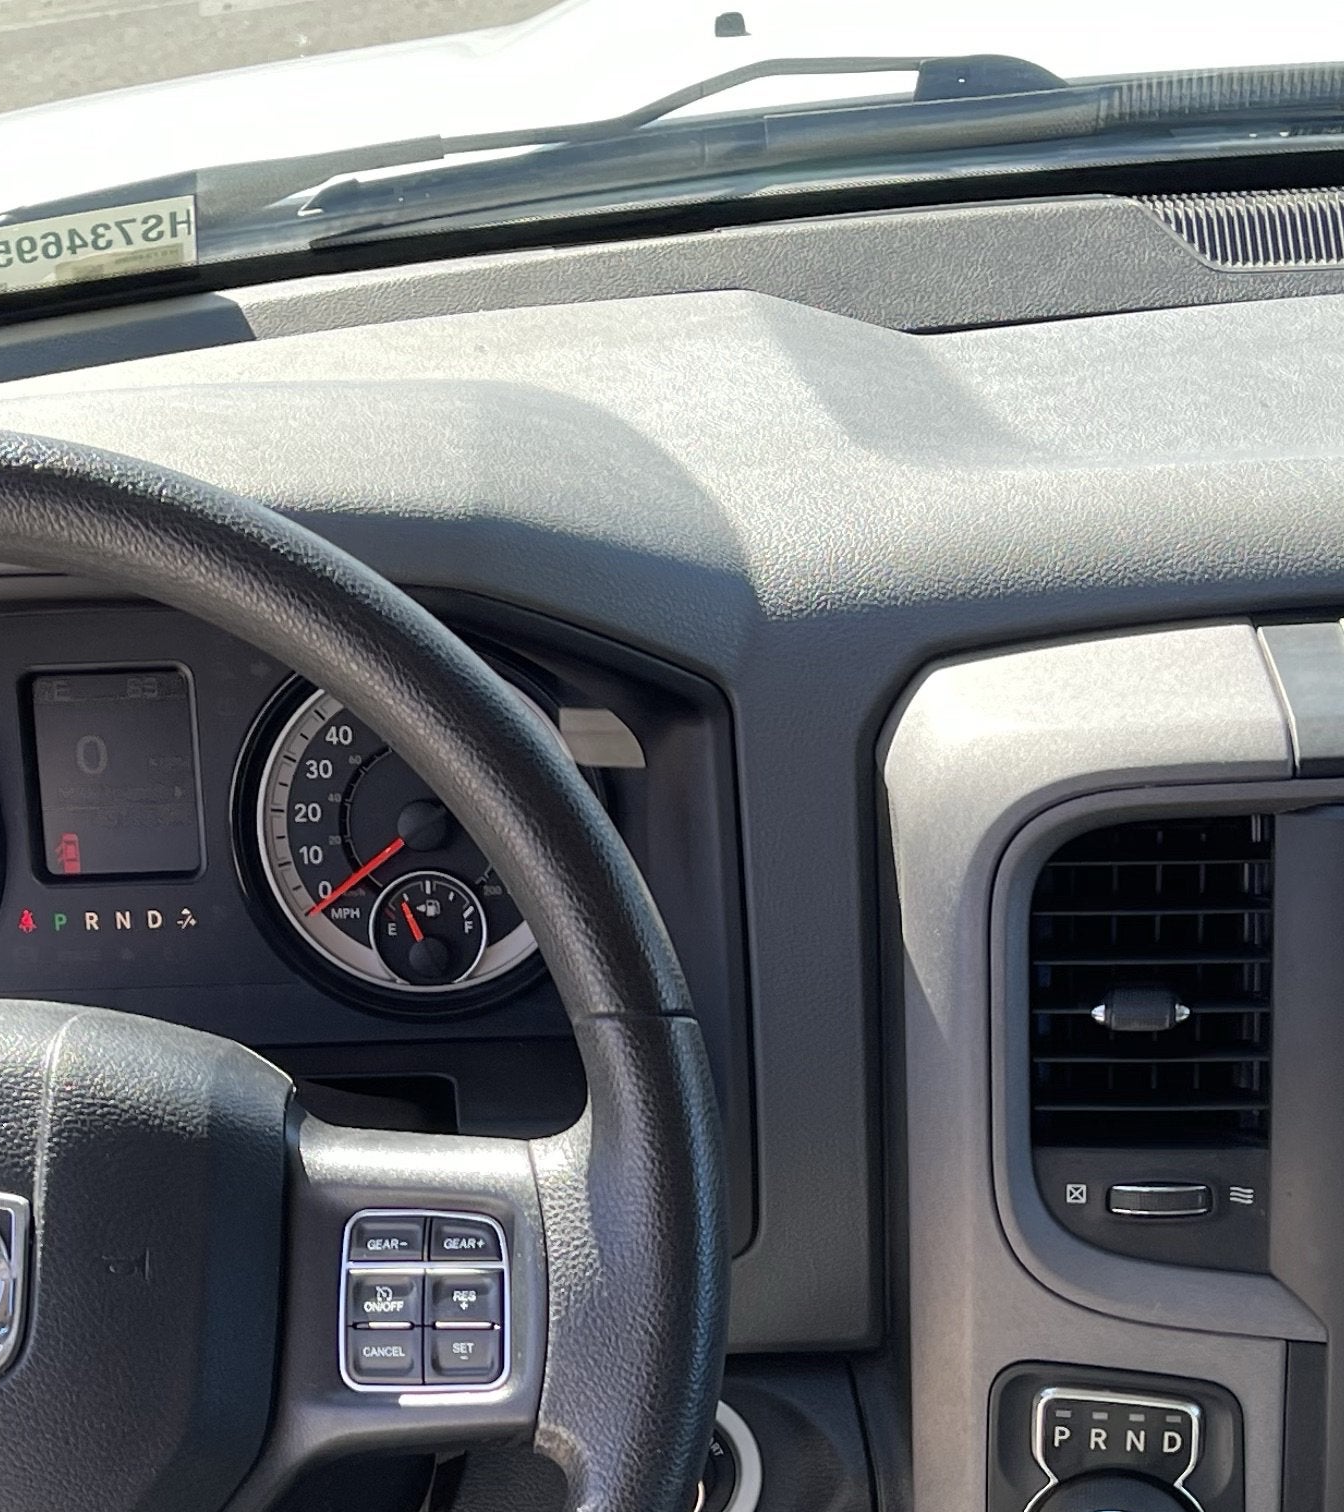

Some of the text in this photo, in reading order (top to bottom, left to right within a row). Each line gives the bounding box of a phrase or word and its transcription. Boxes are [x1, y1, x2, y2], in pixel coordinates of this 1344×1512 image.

[325, 726, 353, 745] 40
[77, 735, 106, 774] 0
[306, 760, 333, 779] 30
[294, 803, 322, 823] 20
[299, 846, 323, 864] 10
[318, 881, 332, 899] 0
[54, 911, 162, 930] P R N D
[331, 908, 360, 920] MPH
[388, 923, 397, 936] E
[464, 920, 473, 933] F
[363, 1301, 404, 1312] ON/OFF
[363, 1346, 405, 1357] CANCEL
[452, 1342, 475, 1353] SET
[1054, 1426, 1181, 1453] P R N D
